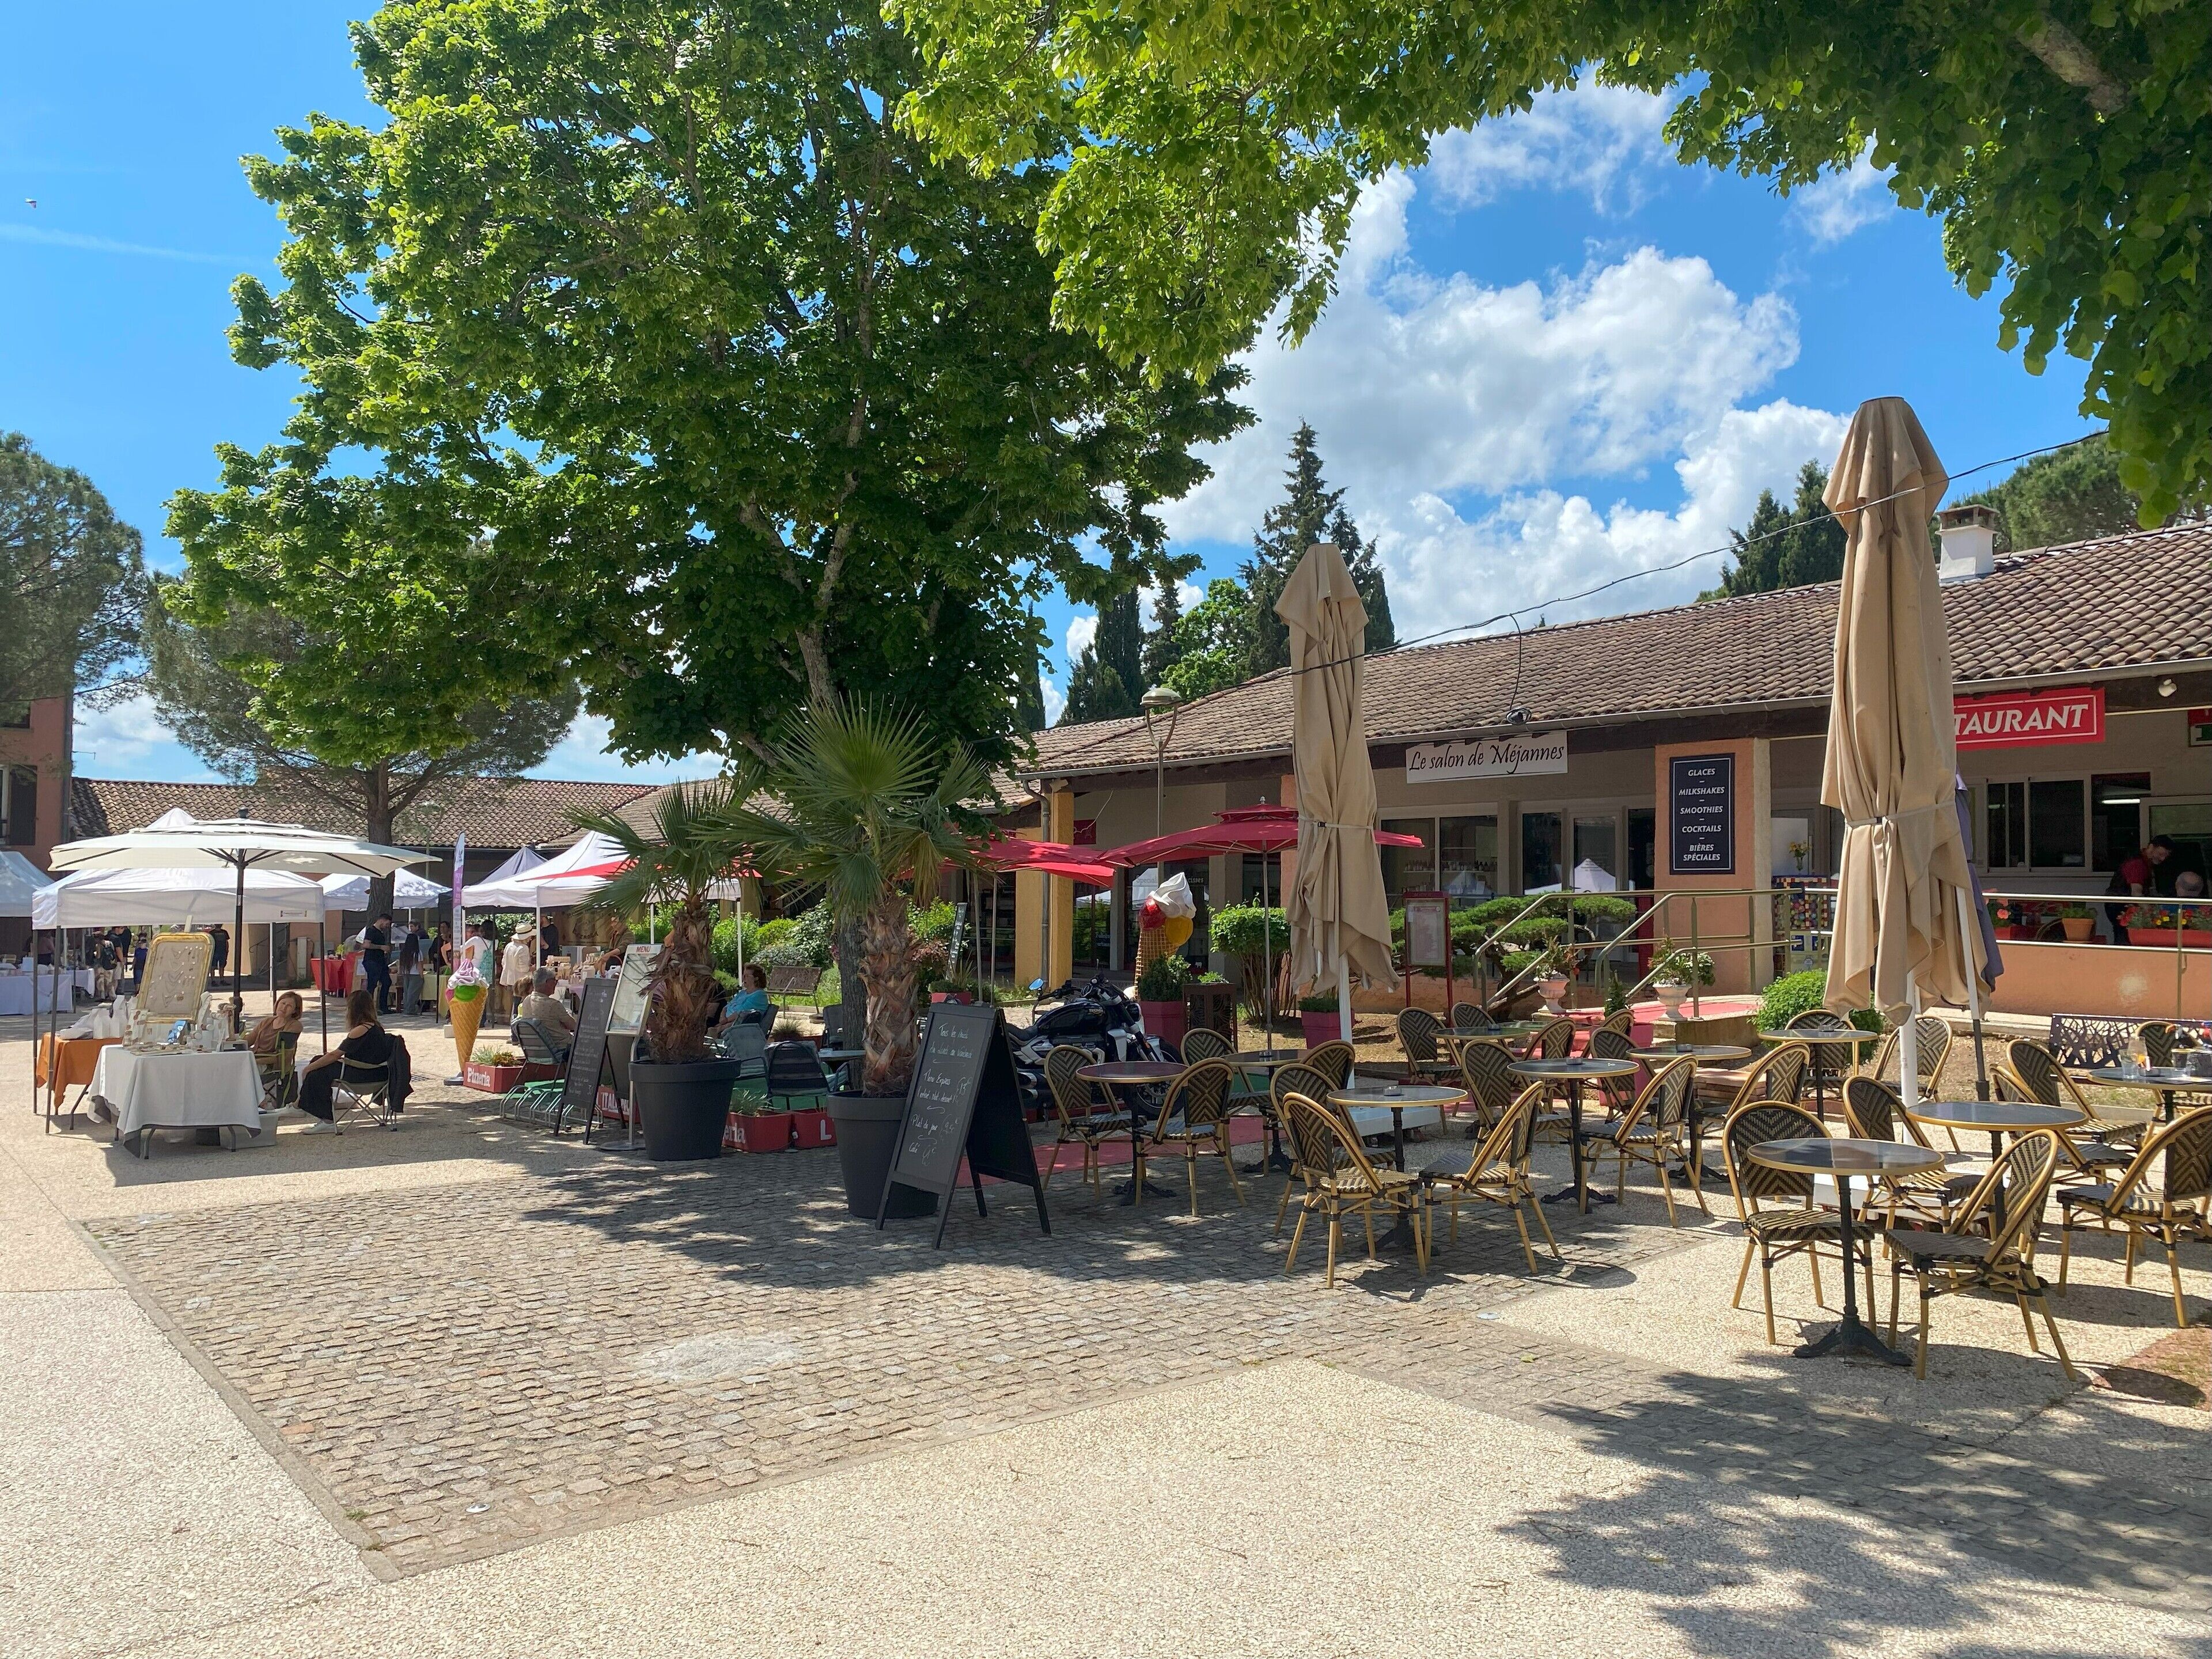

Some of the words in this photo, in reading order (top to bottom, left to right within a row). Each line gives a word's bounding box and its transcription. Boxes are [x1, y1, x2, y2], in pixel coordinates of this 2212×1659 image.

[1409, 751, 1426, 771] Le
[1429, 745, 1464, 769] salon
[1468, 742, 1484, 766] de
[1490, 743, 1565, 775] Méjannes
[1688, 768, 1716, 777] GLACES
[1678, 786, 1725, 796] MILKSHAKES
[1679, 805, 1724, 815] SMOOTHIES
[1681, 824, 1722, 833] COCKTAILS
[1689, 843, 1714, 851] BIÈRES
[1683, 853, 1721, 861] SPÉCIALES
[467, 1067, 490, 1087] Pizzeria
